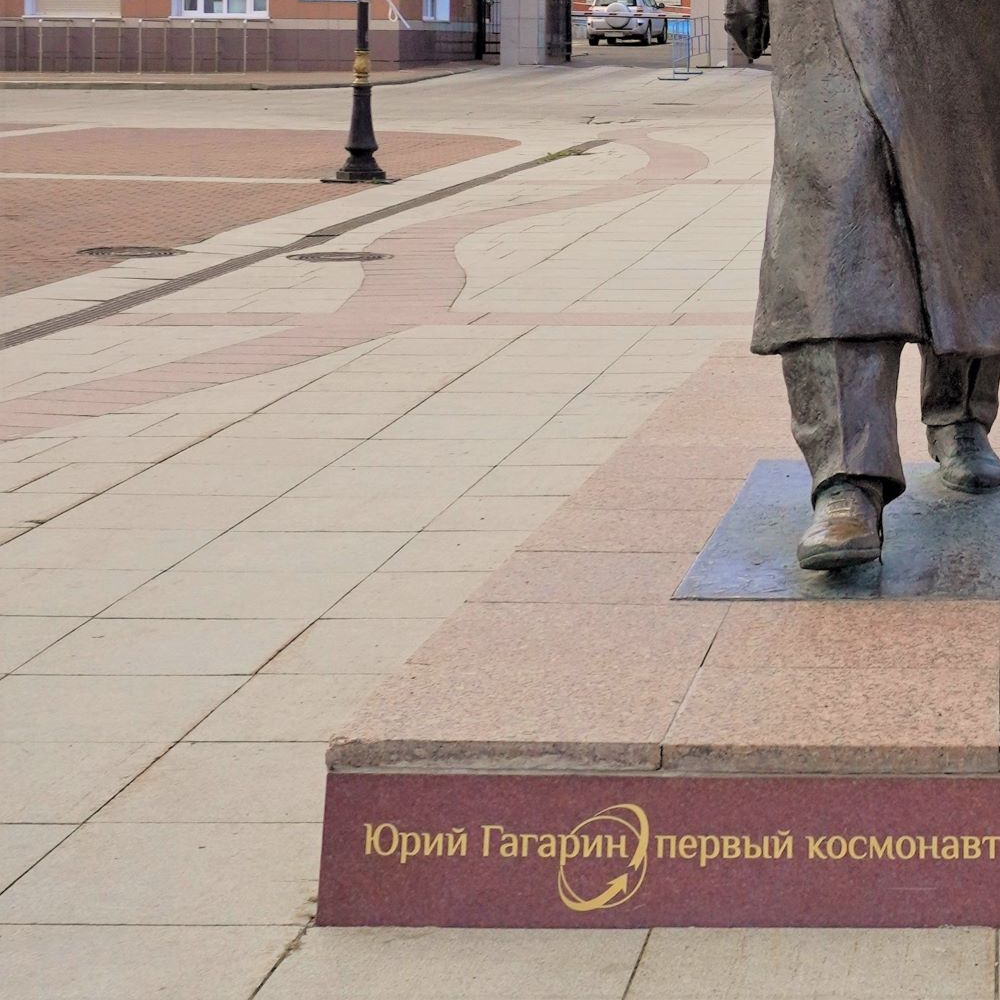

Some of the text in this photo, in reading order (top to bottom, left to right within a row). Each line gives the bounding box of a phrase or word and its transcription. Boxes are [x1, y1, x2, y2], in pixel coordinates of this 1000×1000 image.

[364, 823, 468, 864] Юрий
[481, 824, 629, 866] Гагарин
[655, 829, 794, 867] первый
